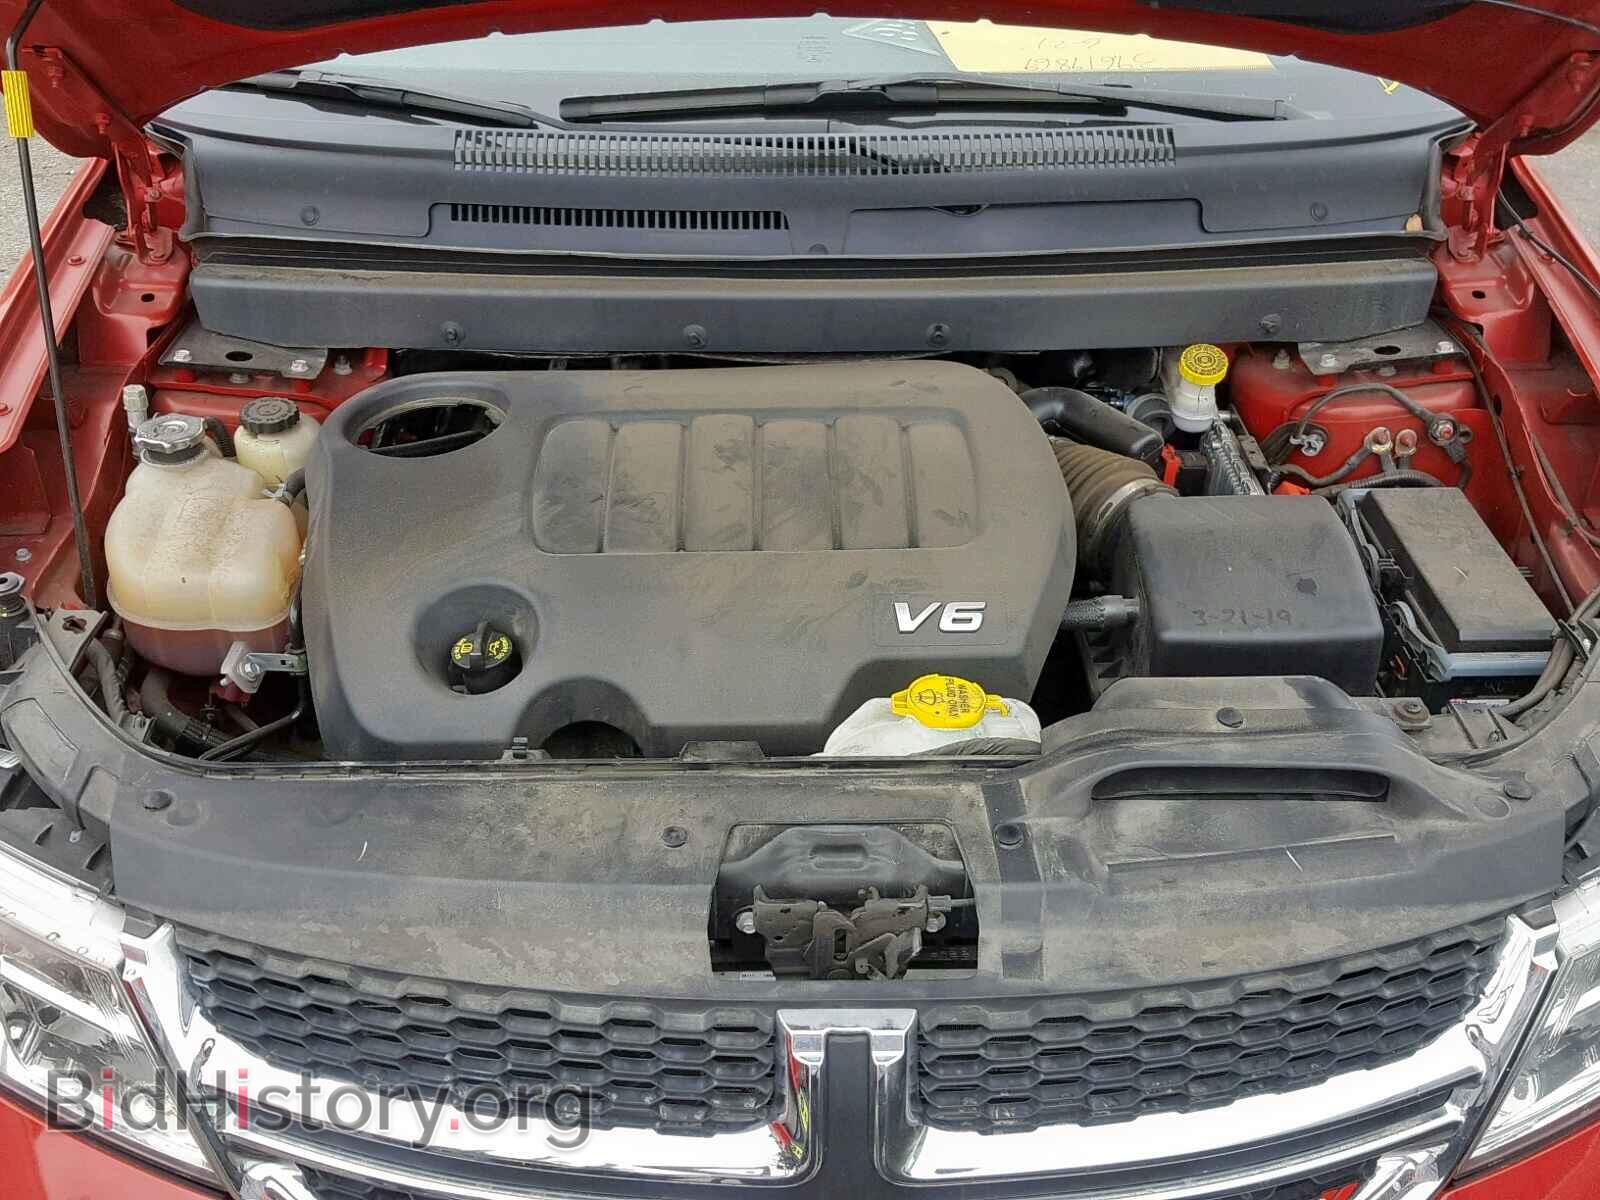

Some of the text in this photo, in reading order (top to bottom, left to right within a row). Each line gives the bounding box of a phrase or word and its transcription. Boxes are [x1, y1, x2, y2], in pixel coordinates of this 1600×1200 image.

[893, 601, 987, 634] V6
[947, 699, 959, 720] ONLY
[958, 683, 970, 714] WASHER
